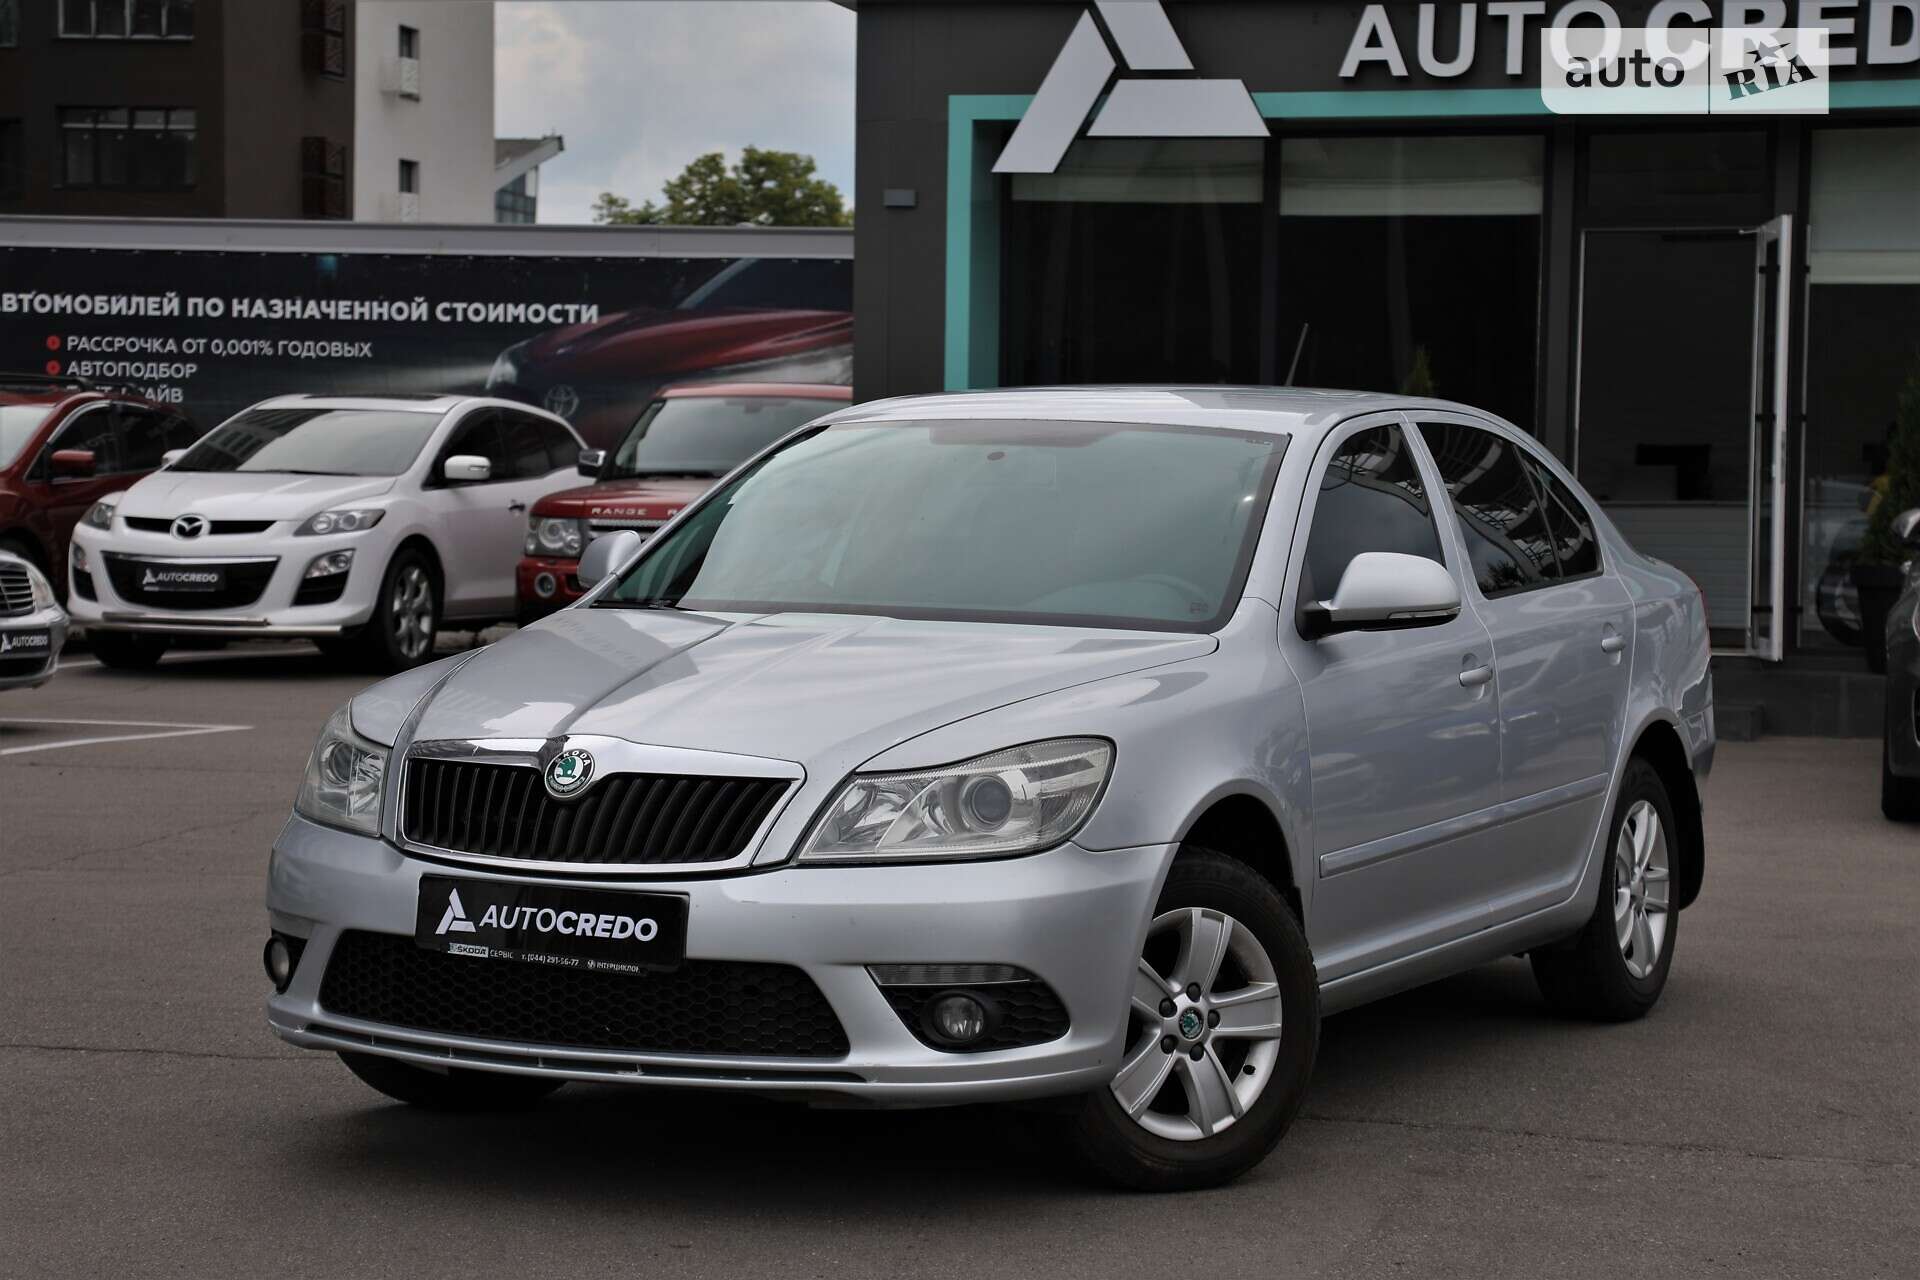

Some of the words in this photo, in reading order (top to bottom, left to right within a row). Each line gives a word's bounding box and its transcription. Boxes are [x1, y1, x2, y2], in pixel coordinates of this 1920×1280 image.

[0, 291, 180, 318] ВТОМОБИЛЕЙ
[187, 297, 224, 318] ПО
[232, 297, 428, 322] НАЗНАЧЕННОЙ
[435, 301, 599, 325] СТОИМОСТИ
[67, 336, 178, 354] РАССРОЧКА
[182, 339, 208, 355] ОТ
[211, 340, 273, 358] 0,001%
[278, 340, 373, 359] ГОДОВЫХ
[67, 360, 198, 380] АВТОПОДБОР
[591, 507, 648, 516] RANGE
[157, 571, 219, 583] AUTOCREDO
[479, 904, 658, 942] AUTOCREDO
